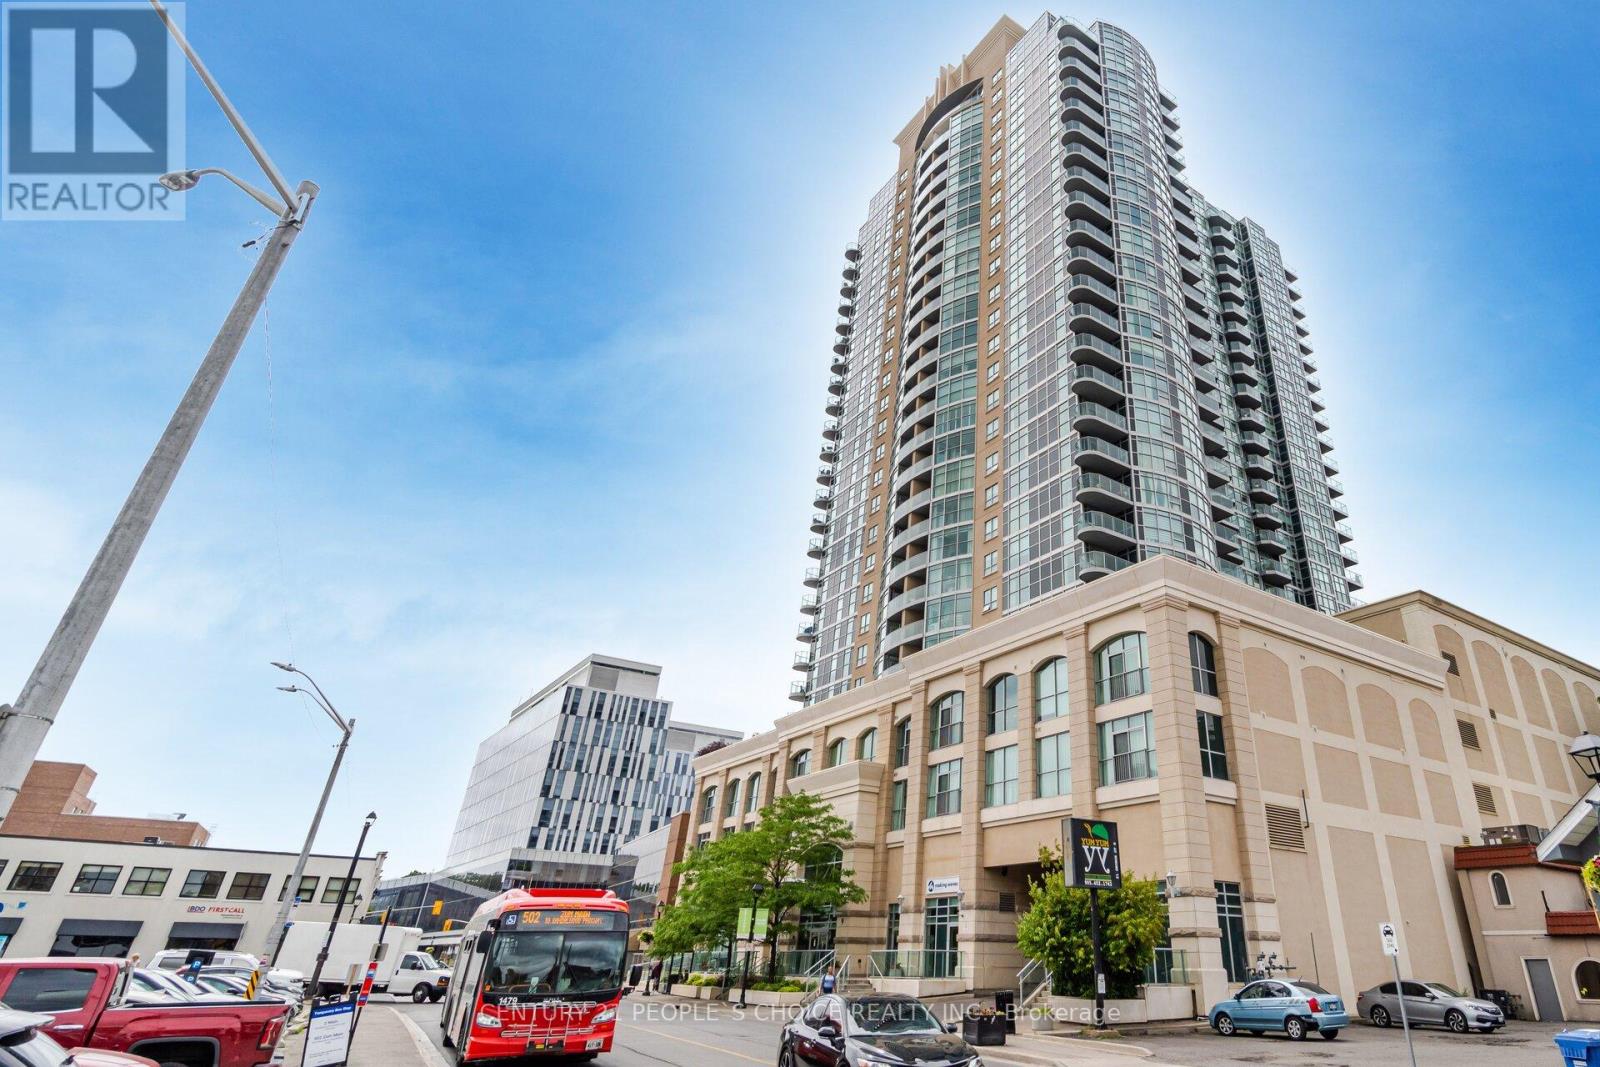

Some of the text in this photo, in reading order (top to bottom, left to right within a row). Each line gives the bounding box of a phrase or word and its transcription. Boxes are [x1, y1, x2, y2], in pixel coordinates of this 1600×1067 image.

[1095, 839, 1109, 847] YUM
[522, 911, 541, 924] 502
[498, 996, 518, 1005] 1479
